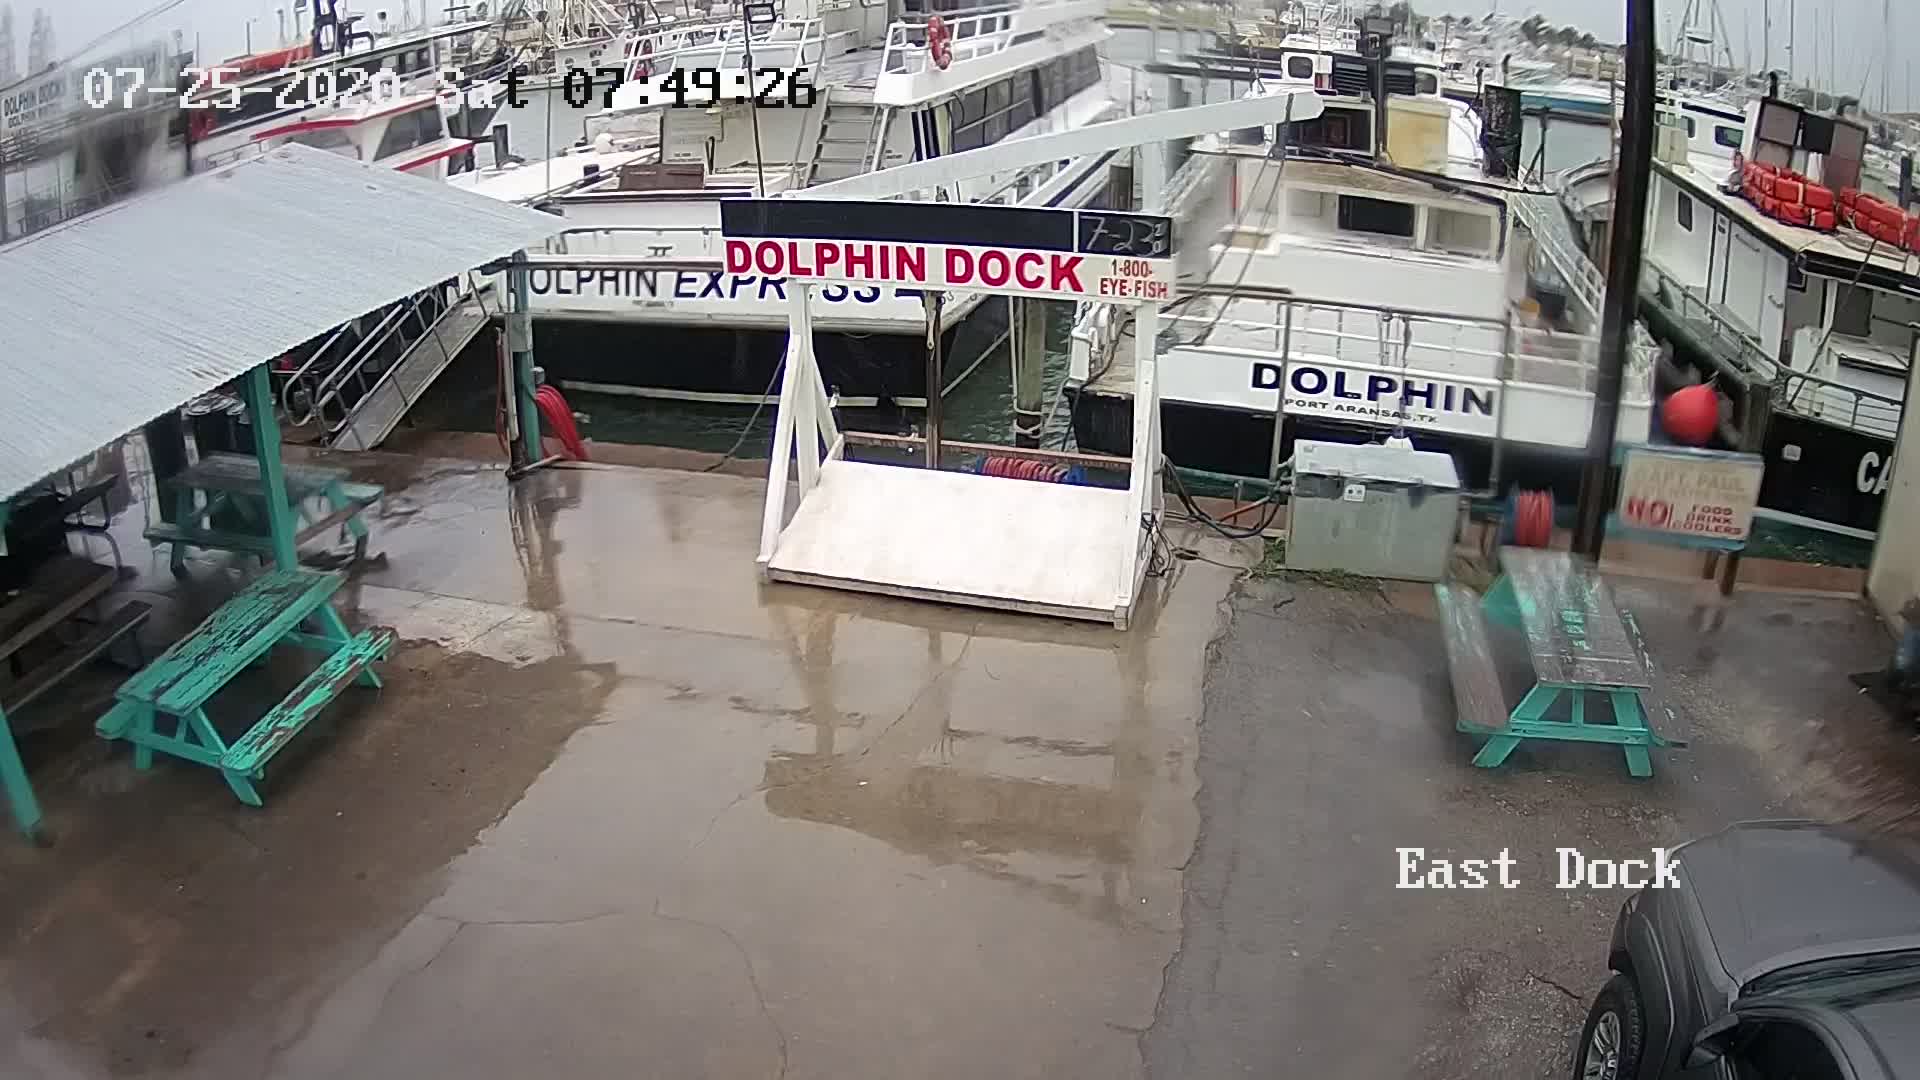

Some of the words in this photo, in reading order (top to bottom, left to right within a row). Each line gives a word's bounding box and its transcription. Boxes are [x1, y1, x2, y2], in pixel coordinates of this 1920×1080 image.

[726, 240, 926, 282] DOLPHIN
[945, 248, 1084, 293] DOCK
[1111, 259, 1153, 278] 1-800-
[528, 268, 657, 297] OLPHIN
[1100, 277, 1168, 299] EYE-FISH
[1251, 362, 1494, 416] DOLPHIN
[1284, 399, 1329, 409] PORT
[1627, 496, 1668, 526] NO
[1685, 513, 1733, 525] DRINK
[1692, 504, 1733, 516] FOOD
